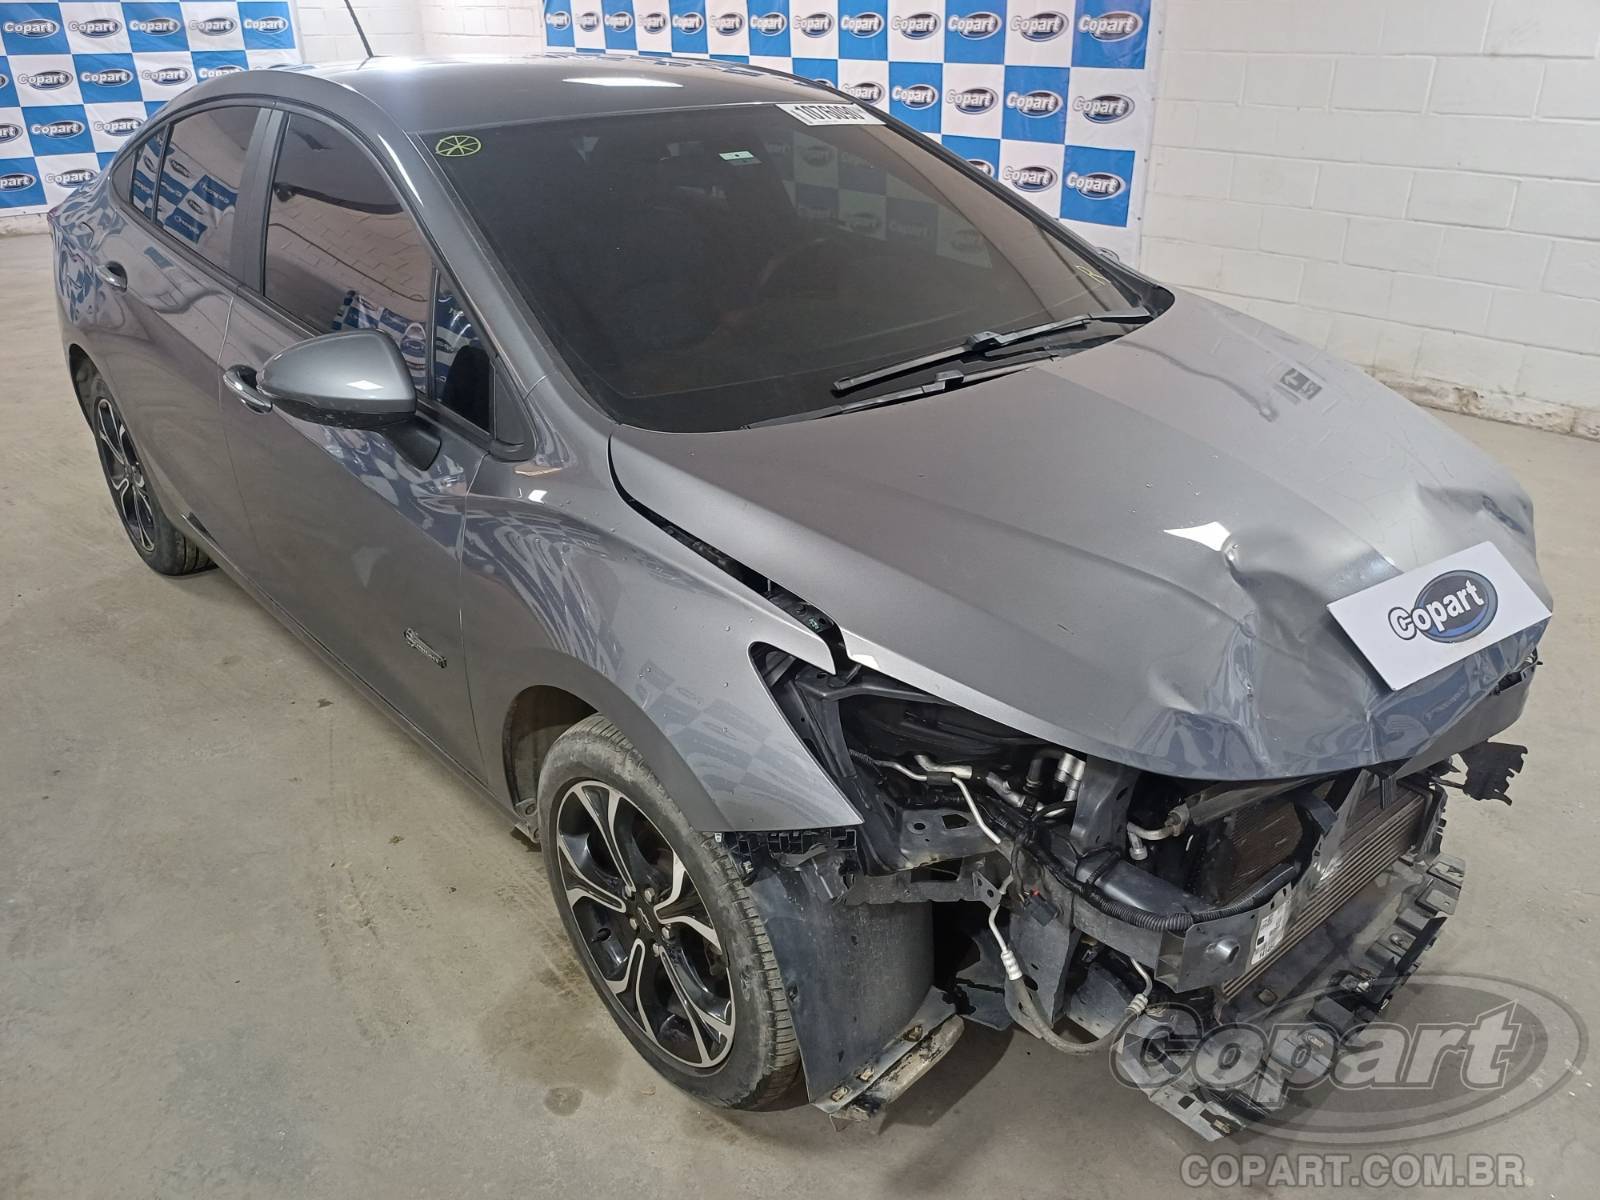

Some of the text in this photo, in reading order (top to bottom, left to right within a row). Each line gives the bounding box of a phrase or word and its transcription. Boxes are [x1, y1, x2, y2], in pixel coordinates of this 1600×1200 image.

[3, 21, 54, 35] Copart
[68, 20, 117, 33] Copart
[129, 19, 174, 32] Copart
[188, 19, 232, 31] Copart
[243, 18, 284, 31] Copart
[751, 14, 783, 30] Copart
[793, 15, 830, 33] Copart
[841, 15, 878, 33] Copart
[891, 15, 936, 35] Copart
[948, 15, 994, 35] Copart
[1010, 15, 1061, 36] Copart
[1079, 14, 1136, 37] Copart
[18, 73, 67, 86] Copart
[81, 70, 128, 84] Copart
[141, 69, 186, 81] Copart
[892, 84, 935, 105] Copart
[946, 88, 991, 110] Copart
[1006, 90, 1058, 113] Copart
[1072, 95, 1128, 118] Copart
[31, 123, 80, 136] Copart
[93, 120, 139, 133] Copart
[0, 176, 30, 190] part
[46, 171, 92, 185] Copart
[1003, 165, 1051, 187] Copart
[1066, 170, 1118, 194] Copart
[1388, 578, 1486, 641] Copart
